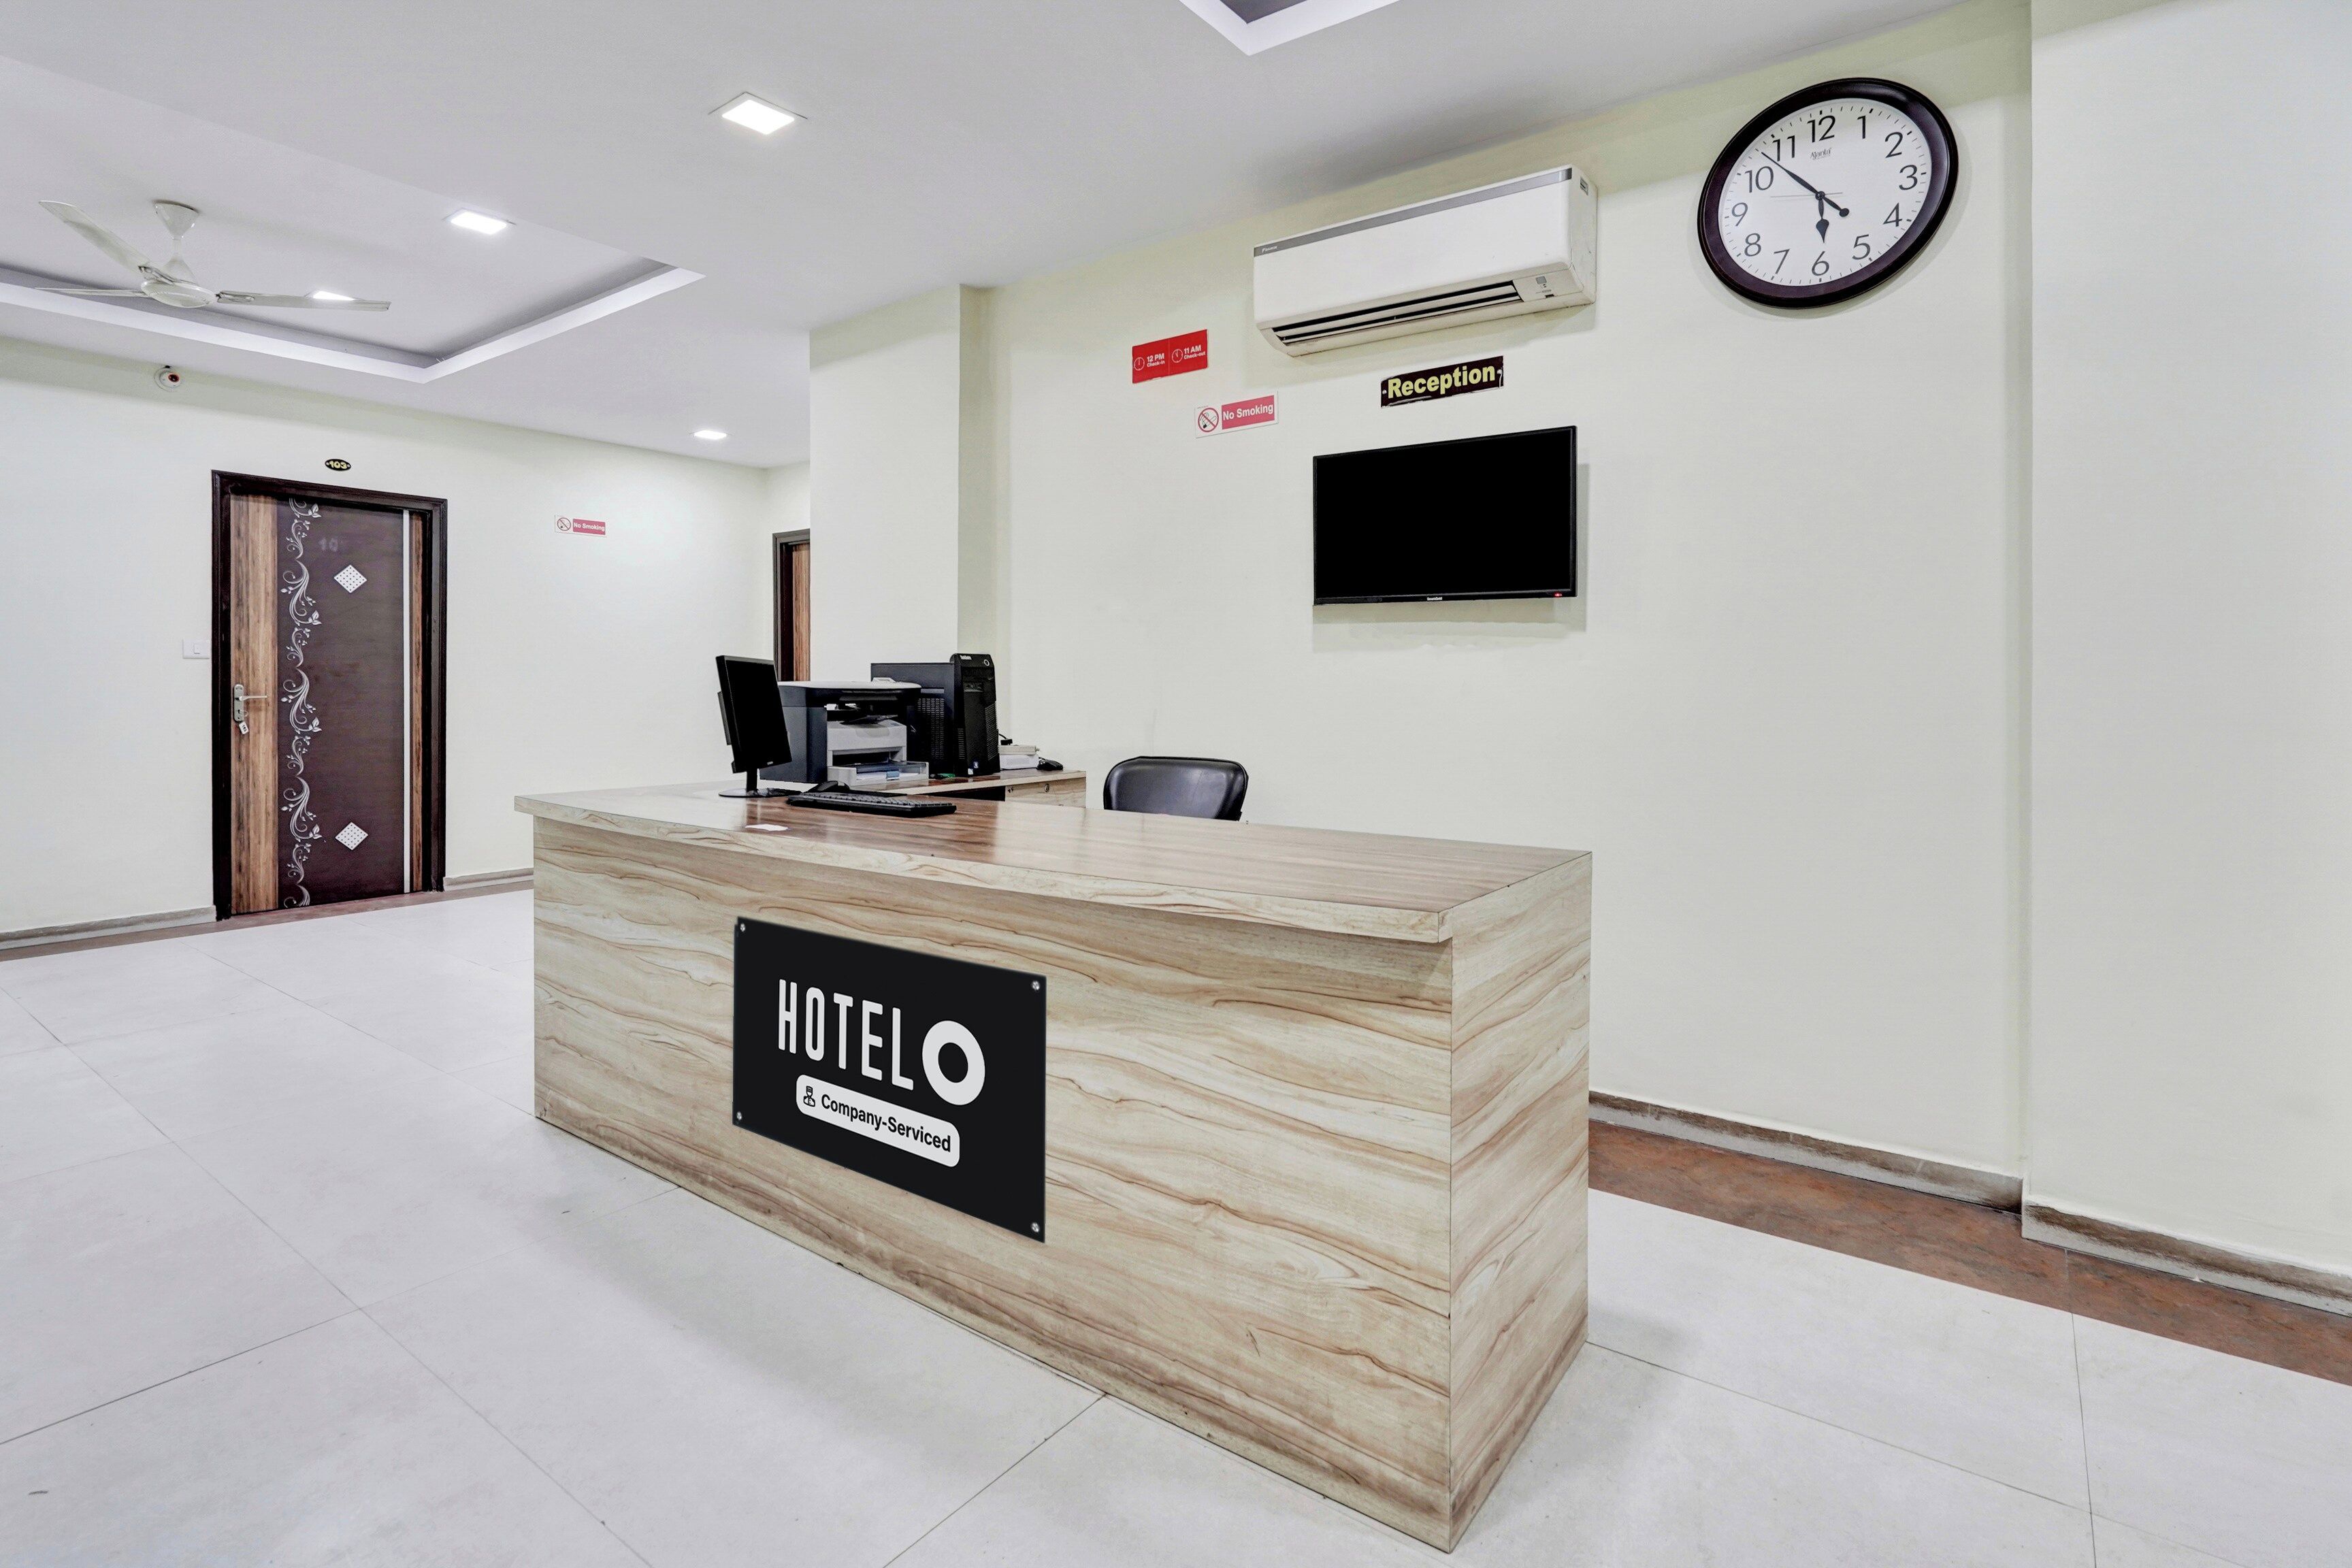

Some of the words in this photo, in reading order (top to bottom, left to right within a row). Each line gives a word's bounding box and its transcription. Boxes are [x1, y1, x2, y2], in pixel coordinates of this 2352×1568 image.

[1808, 116, 1835, 143] 12
[1857, 116, 1866, 140] 1
[1772, 135, 1795, 162] 11
[1884, 131, 1904, 158] 2
[1745, 165, 1774, 193] 10
[1899, 165, 1918, 191] 3
[1731, 202, 1748, 227] 9
[1883, 202, 1903, 227] 4
[1744, 233, 1762, 257] 8
[1852, 234, 1871, 260] 5
[1773, 248, 1790, 274] 7
[1811, 250, 1830, 276] 6
[1154, 353, 1164, 361] PM
[1183, 351, 1206, 359] Check-out
[1190, 344, 1201, 353] AM
[1388, 365, 1495, 399] Reception
[1223, 410, 1235, 421] No
[1237, 404, 1274, 419] Smoking
[329, 460, 348, 470] 103
[582, 523, 605, 532] Smoking
[821, 1094, 951, 1152] Company-Serviced
